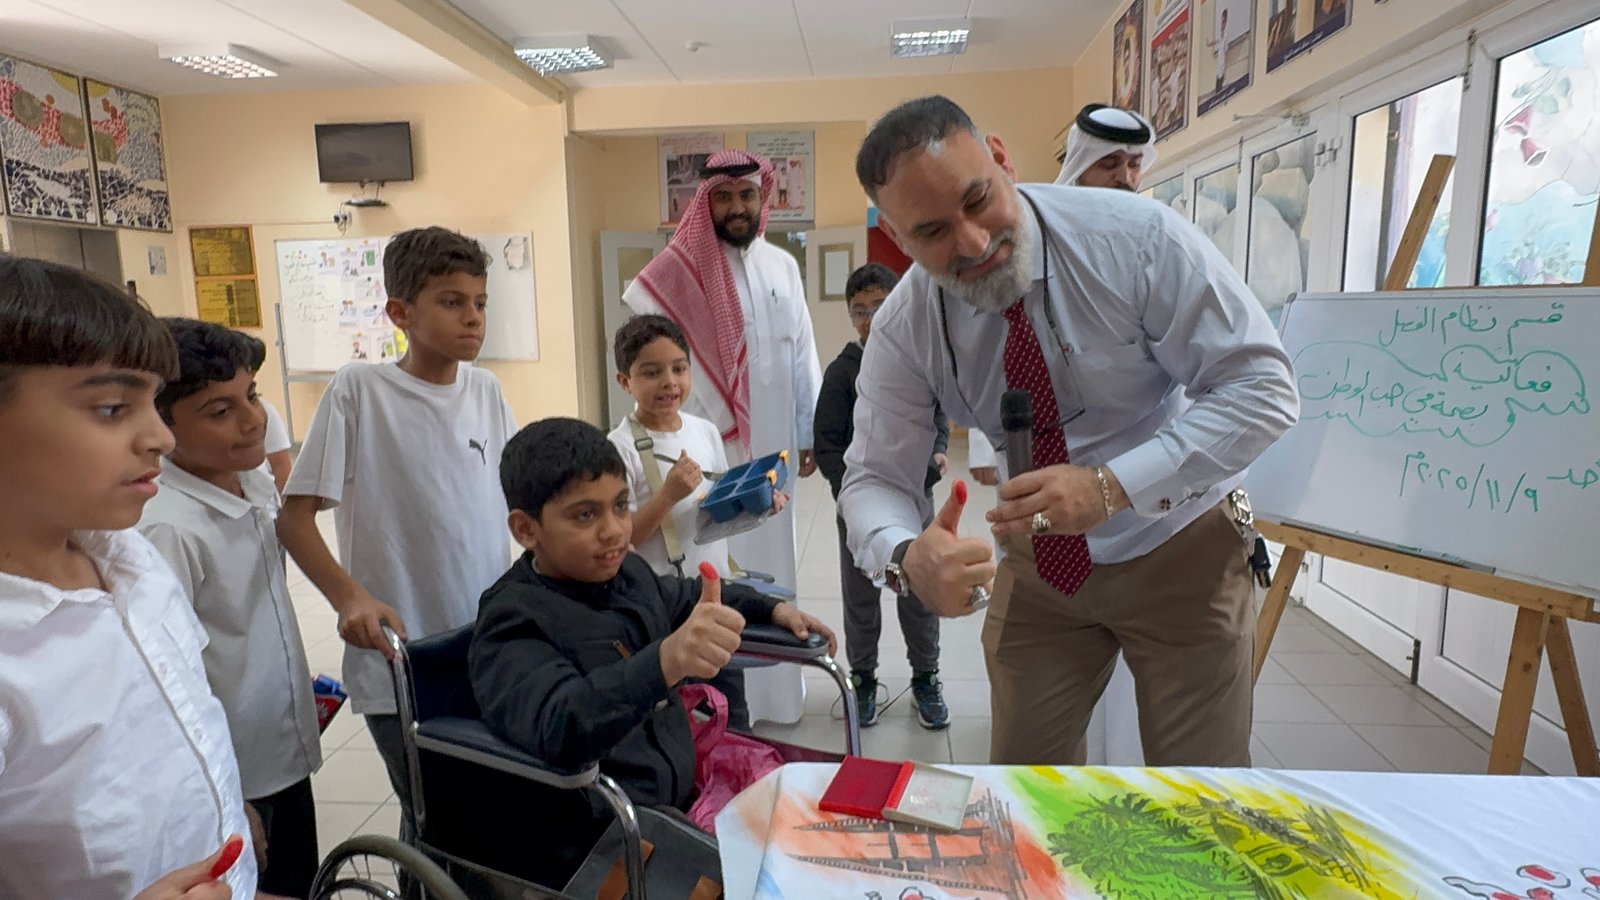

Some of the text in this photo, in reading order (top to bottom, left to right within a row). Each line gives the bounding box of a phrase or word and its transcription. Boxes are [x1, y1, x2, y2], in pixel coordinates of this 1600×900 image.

[1379, 302, 1564, 355] قسم نظام الفصل
